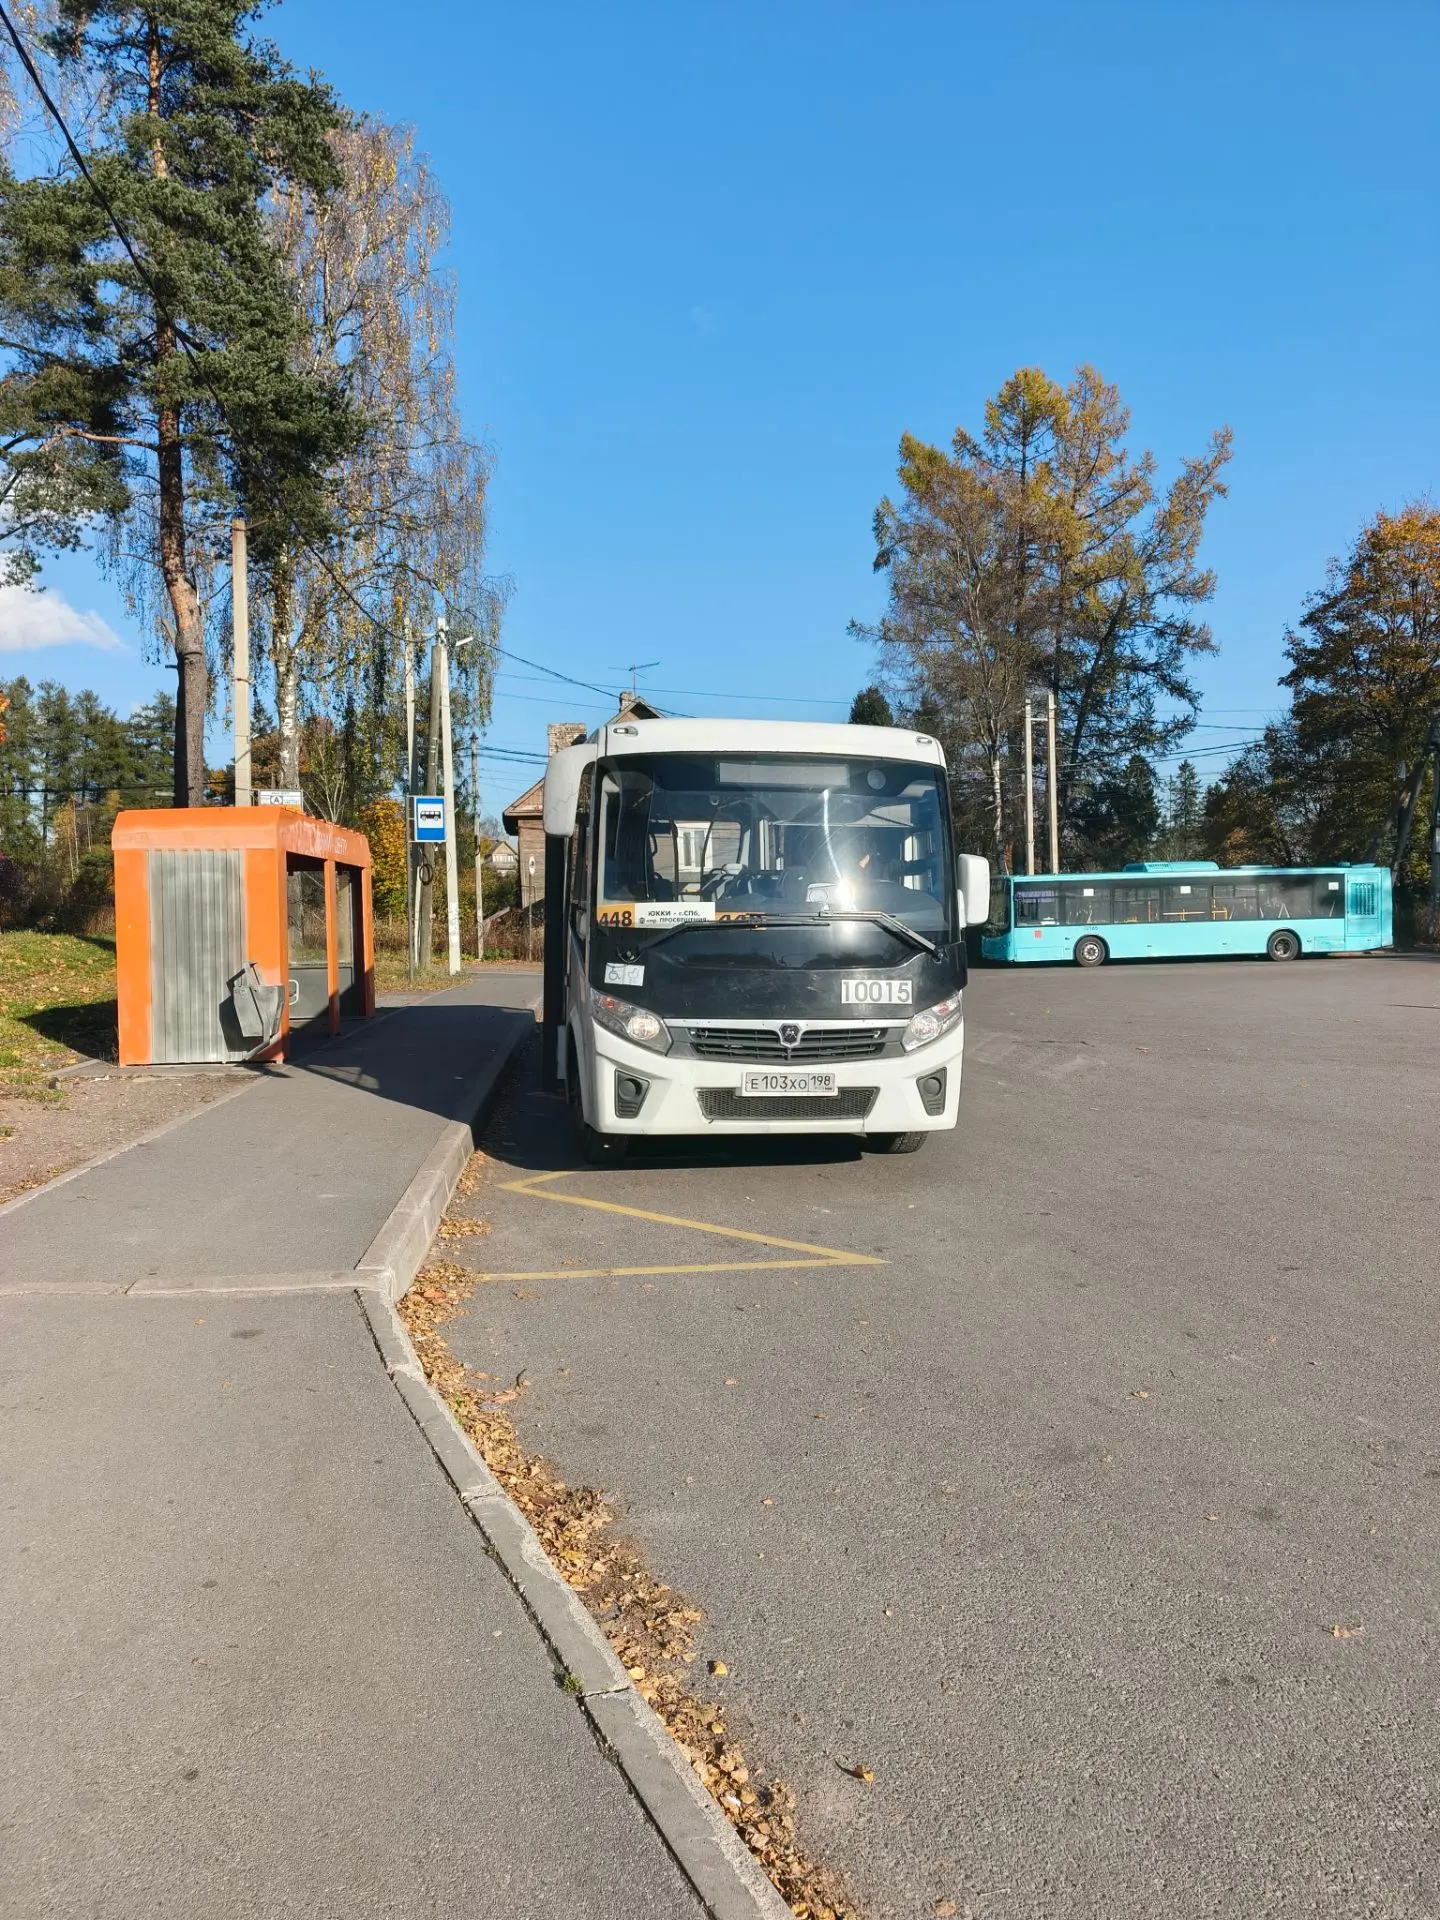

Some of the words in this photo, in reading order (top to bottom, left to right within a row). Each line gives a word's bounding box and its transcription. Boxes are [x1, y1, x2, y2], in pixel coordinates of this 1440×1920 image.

[599, 910, 632, 927] 448
[843, 981, 910, 1003] 10015
[810, 1075, 831, 1086] 198
